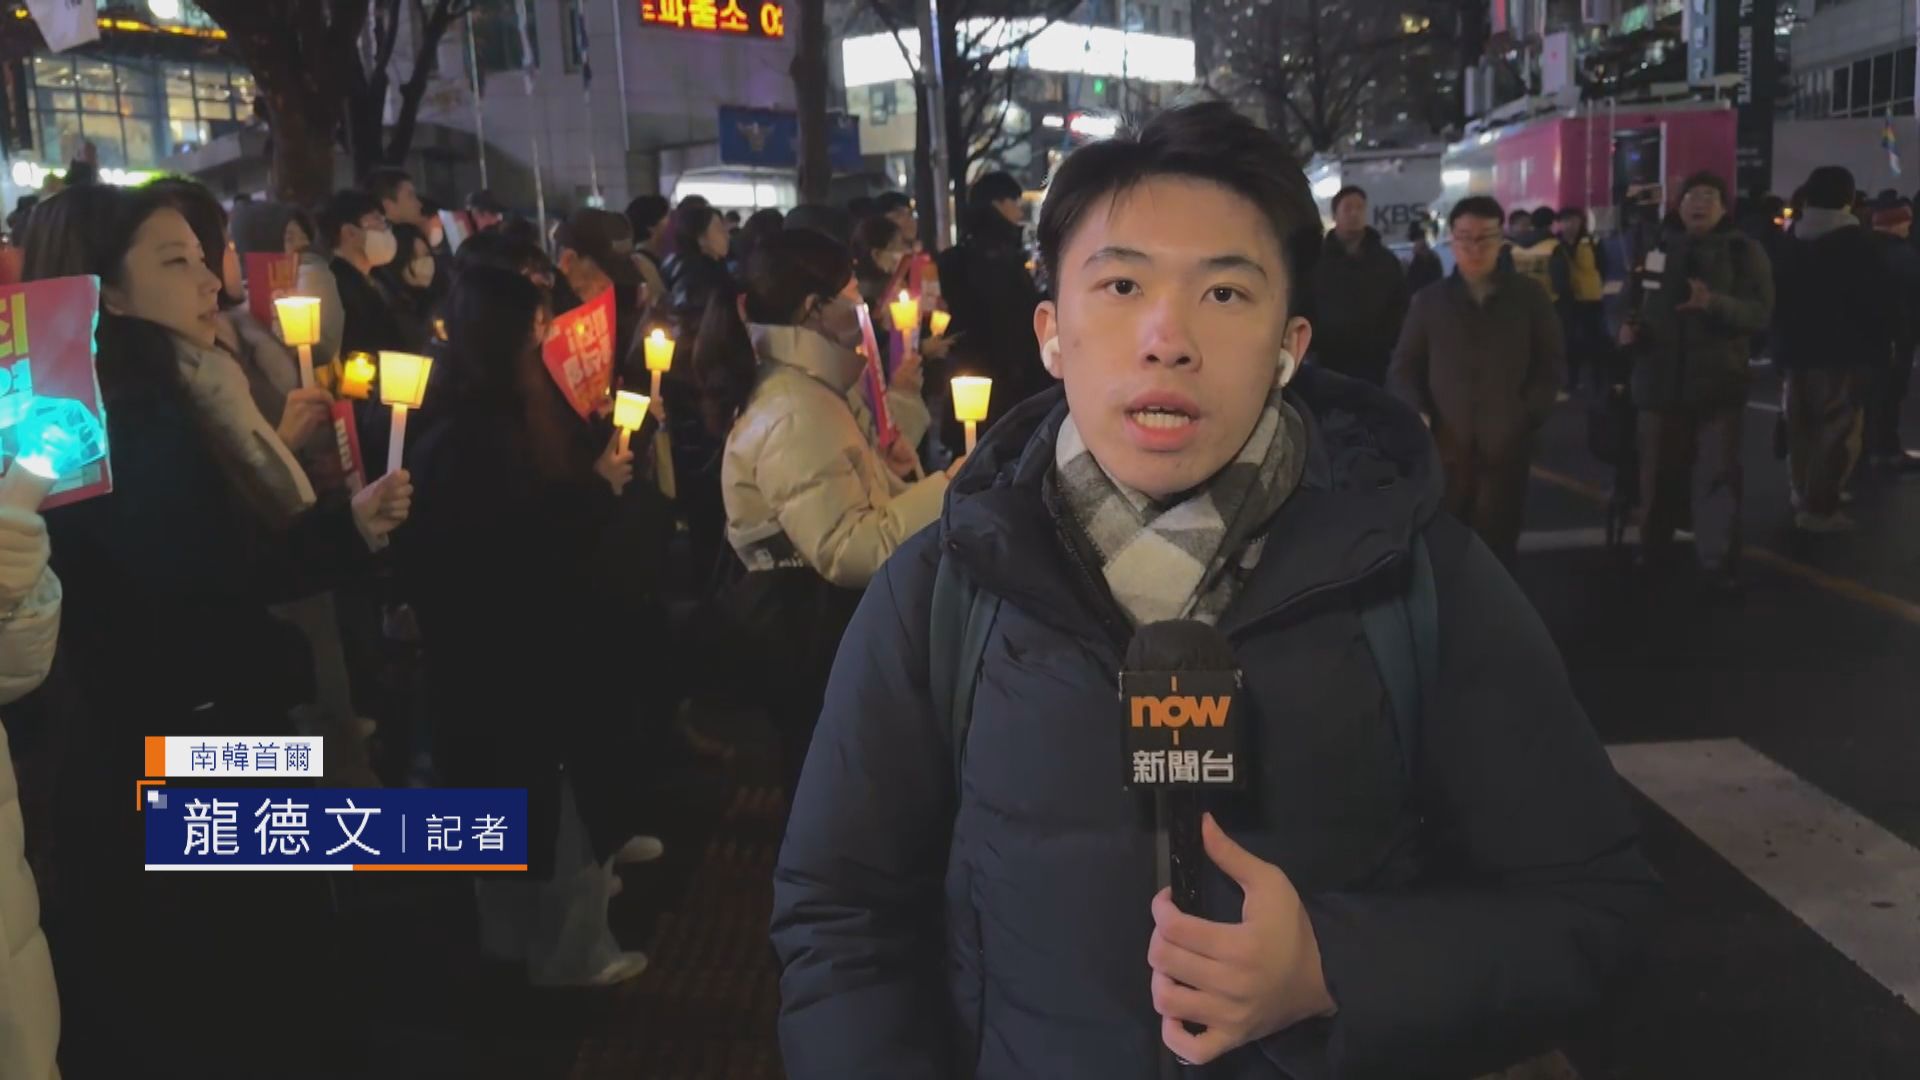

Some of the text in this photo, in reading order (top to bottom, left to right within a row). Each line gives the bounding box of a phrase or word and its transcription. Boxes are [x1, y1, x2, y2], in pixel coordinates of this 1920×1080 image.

[1130, 696, 1232, 728] now
[1132, 750, 1234, 784] 新聞台
